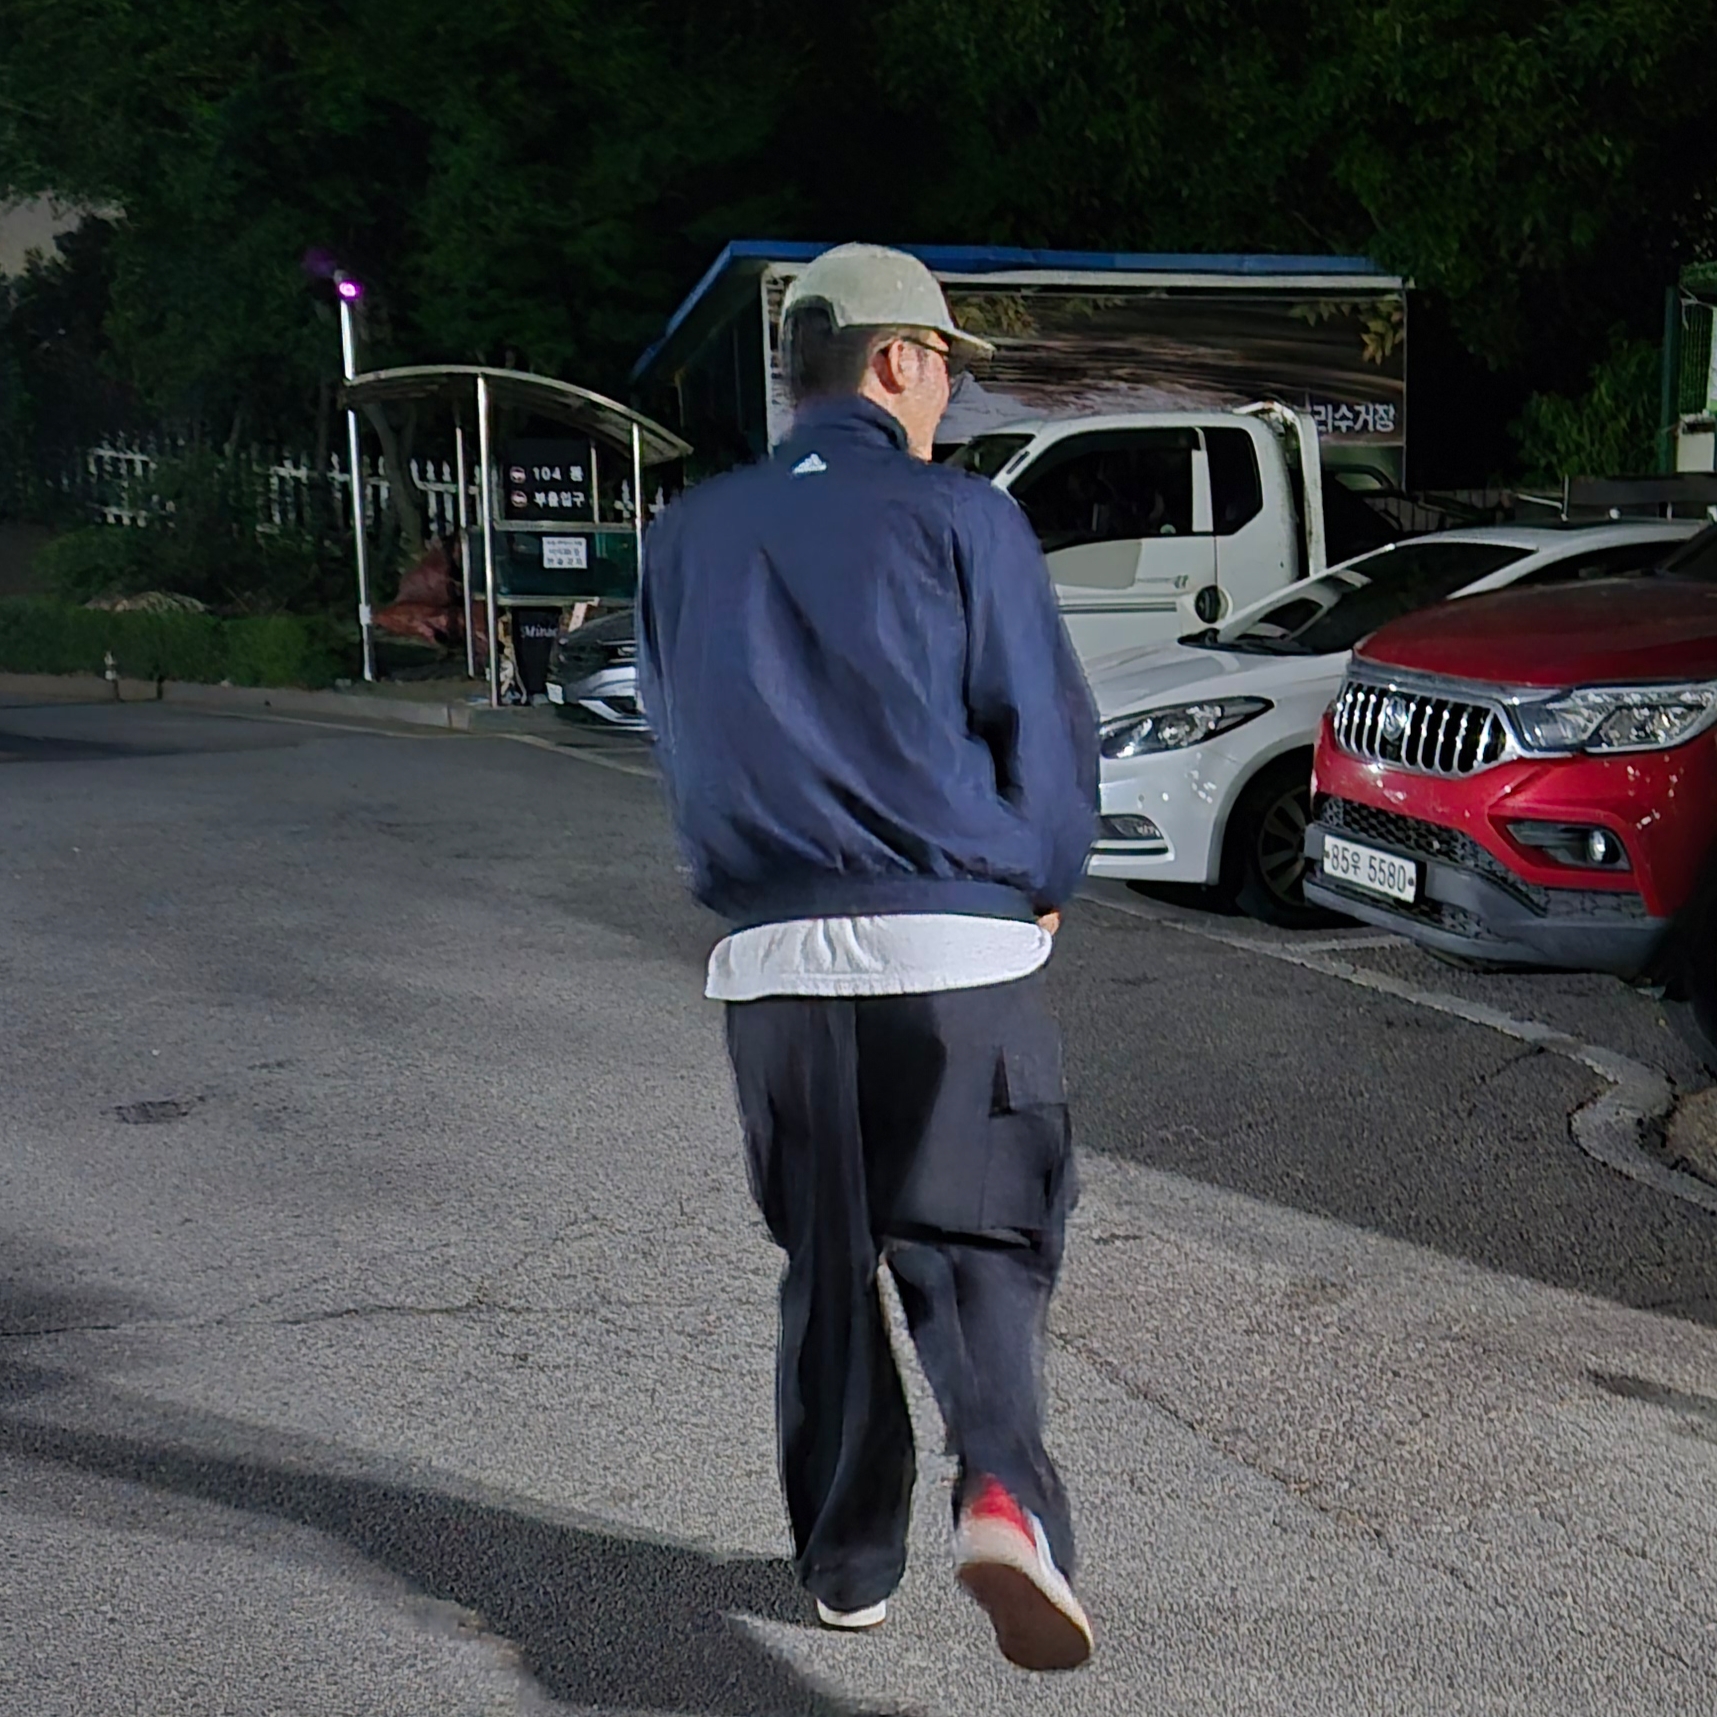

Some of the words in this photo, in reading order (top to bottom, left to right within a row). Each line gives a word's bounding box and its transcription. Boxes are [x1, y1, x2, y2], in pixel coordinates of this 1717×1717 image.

[1312, 402, 1395, 433] 리수거장
[532, 466, 562, 481] 104
[1331, 844, 1360, 876] 85우
[1367, 855, 1407, 893] 5580
